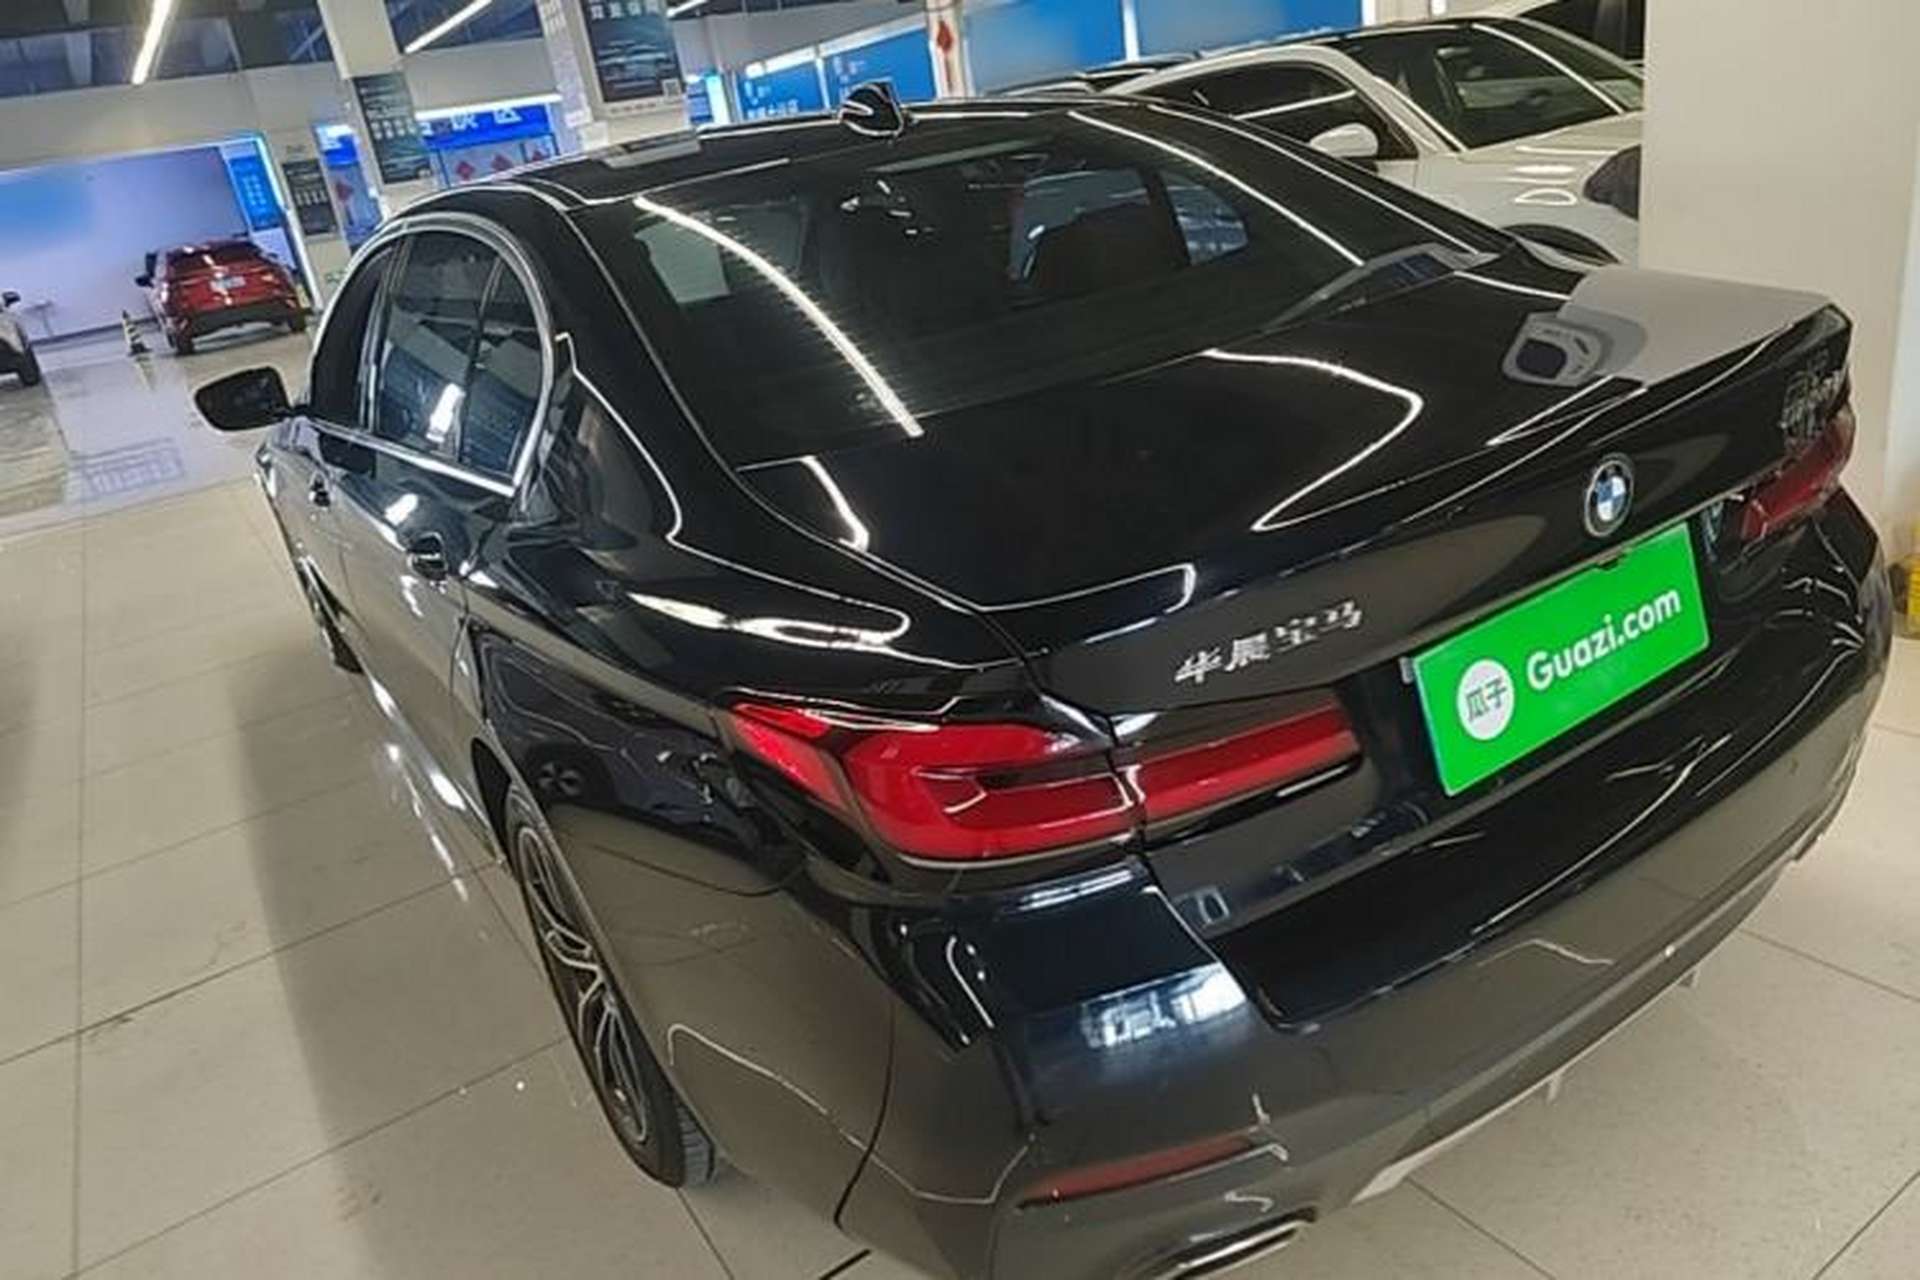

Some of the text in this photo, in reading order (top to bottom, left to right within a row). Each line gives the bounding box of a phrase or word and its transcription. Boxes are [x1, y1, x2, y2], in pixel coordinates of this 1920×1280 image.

[1174, 600, 1363, 684] 华晨宝马
[1526, 589, 1682, 690] Guazi.com
[1464, 675, 1507, 722] 瓜子
